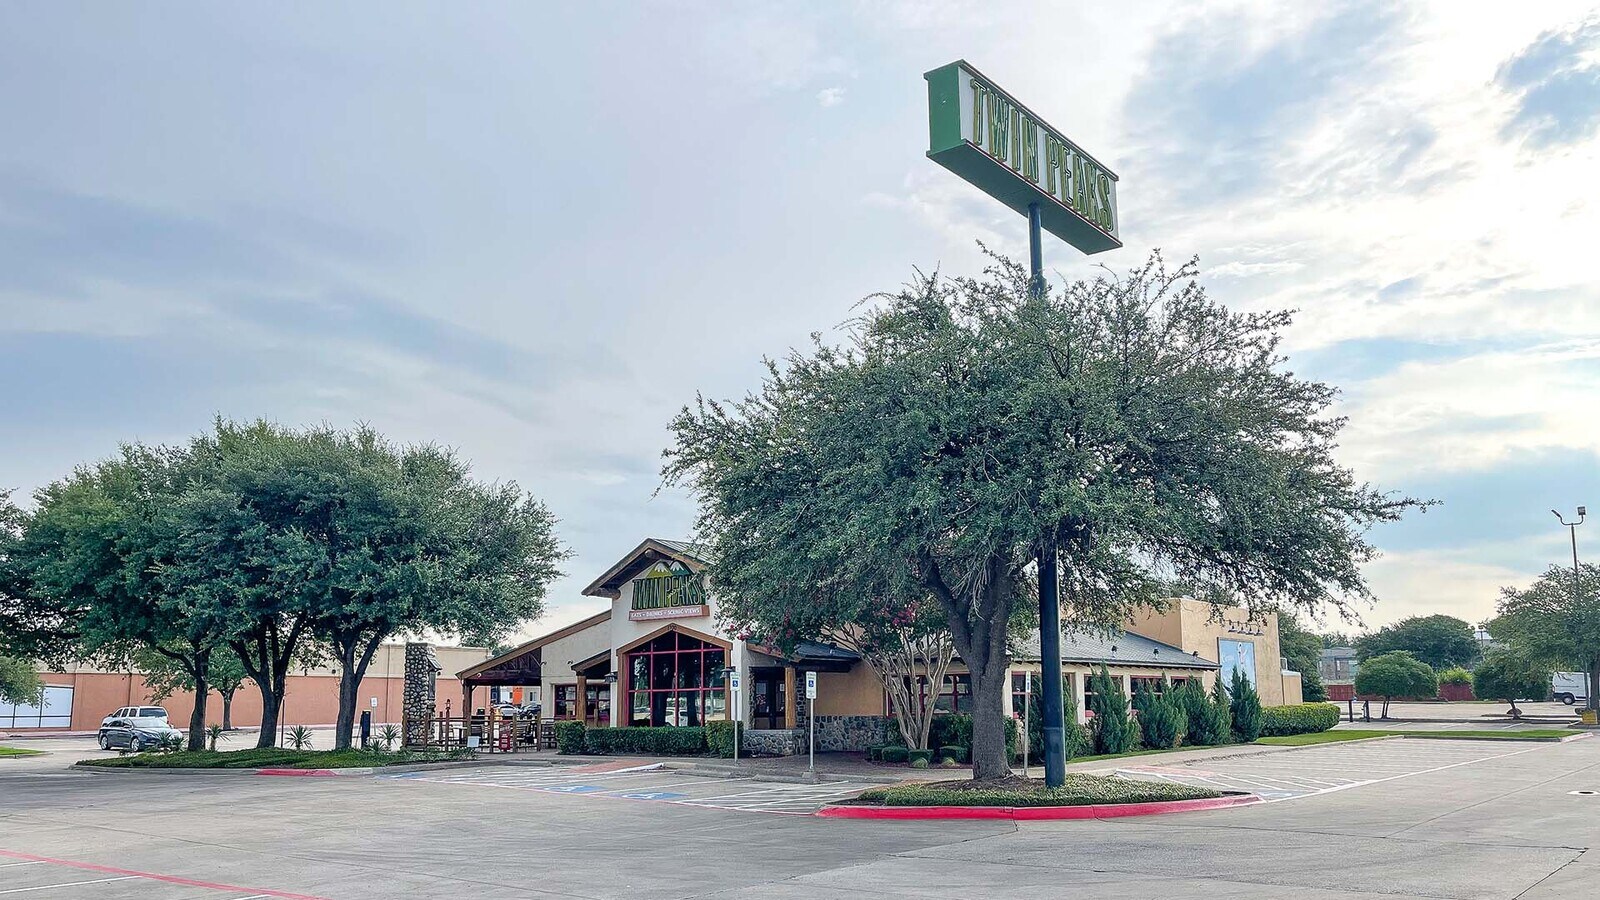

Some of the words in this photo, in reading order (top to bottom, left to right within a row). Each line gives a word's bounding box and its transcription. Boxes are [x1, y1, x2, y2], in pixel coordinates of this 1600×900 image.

[970, 78, 1039, 183] TWIN
[1045, 133, 1114, 232] PEAKS
[632, 578, 661, 610] TWIN
[664, 575, 704, 607] PEAKS
